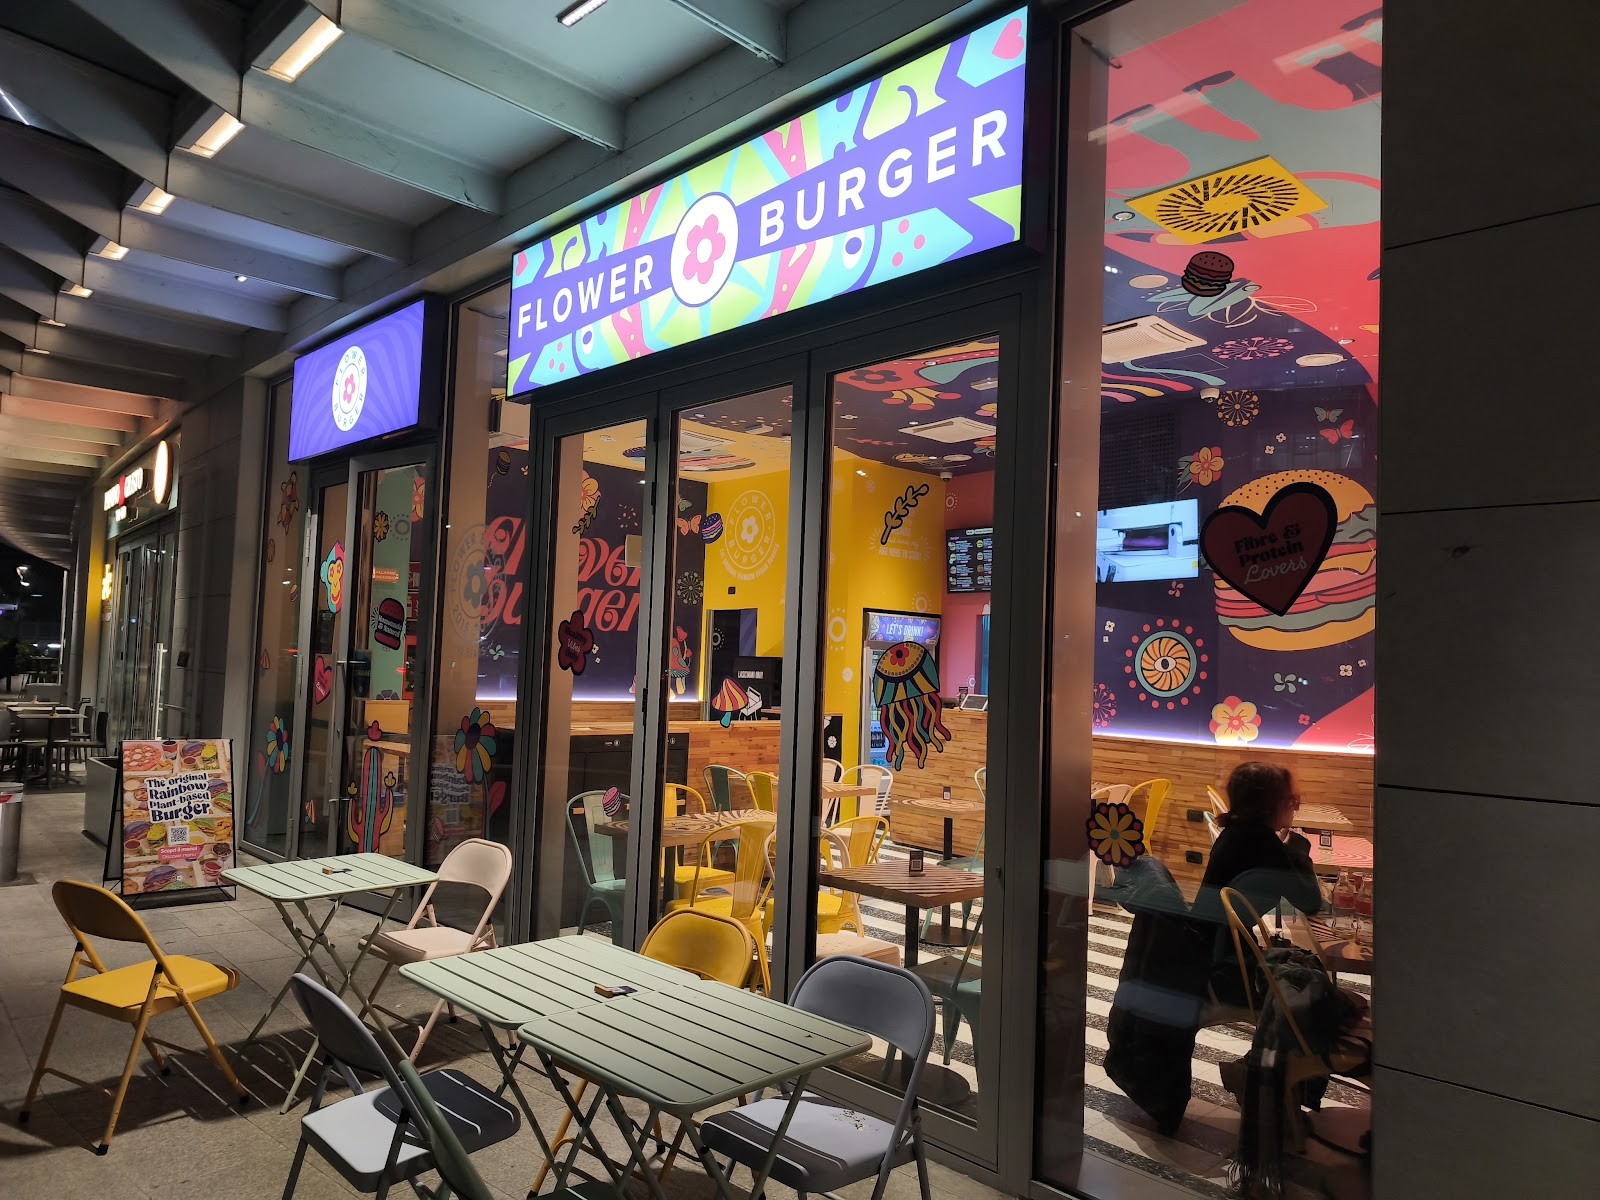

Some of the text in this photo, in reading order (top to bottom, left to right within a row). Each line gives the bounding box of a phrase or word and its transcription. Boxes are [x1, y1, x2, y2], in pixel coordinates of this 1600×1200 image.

[517, 109, 1008, 338] FLOWER BURGER
[335, 350, 366, 386] FLOWER
[333, 393, 364, 427] BURGER
[729, 495, 772, 525] FLOWER
[728, 535, 770, 564] BURGER
[1234, 532, 1278, 554] Fibre
[1238, 541, 1304, 568] Protein
[1244, 555, 1307, 585] Lovers
[886, 623, 924, 637] LET'S DRINK!
[146, 772, 207, 788] The original
[149, 781, 208, 800] Rainbow
[149, 792, 210, 810] Plant-based
[151, 801, 210, 822] Burger
